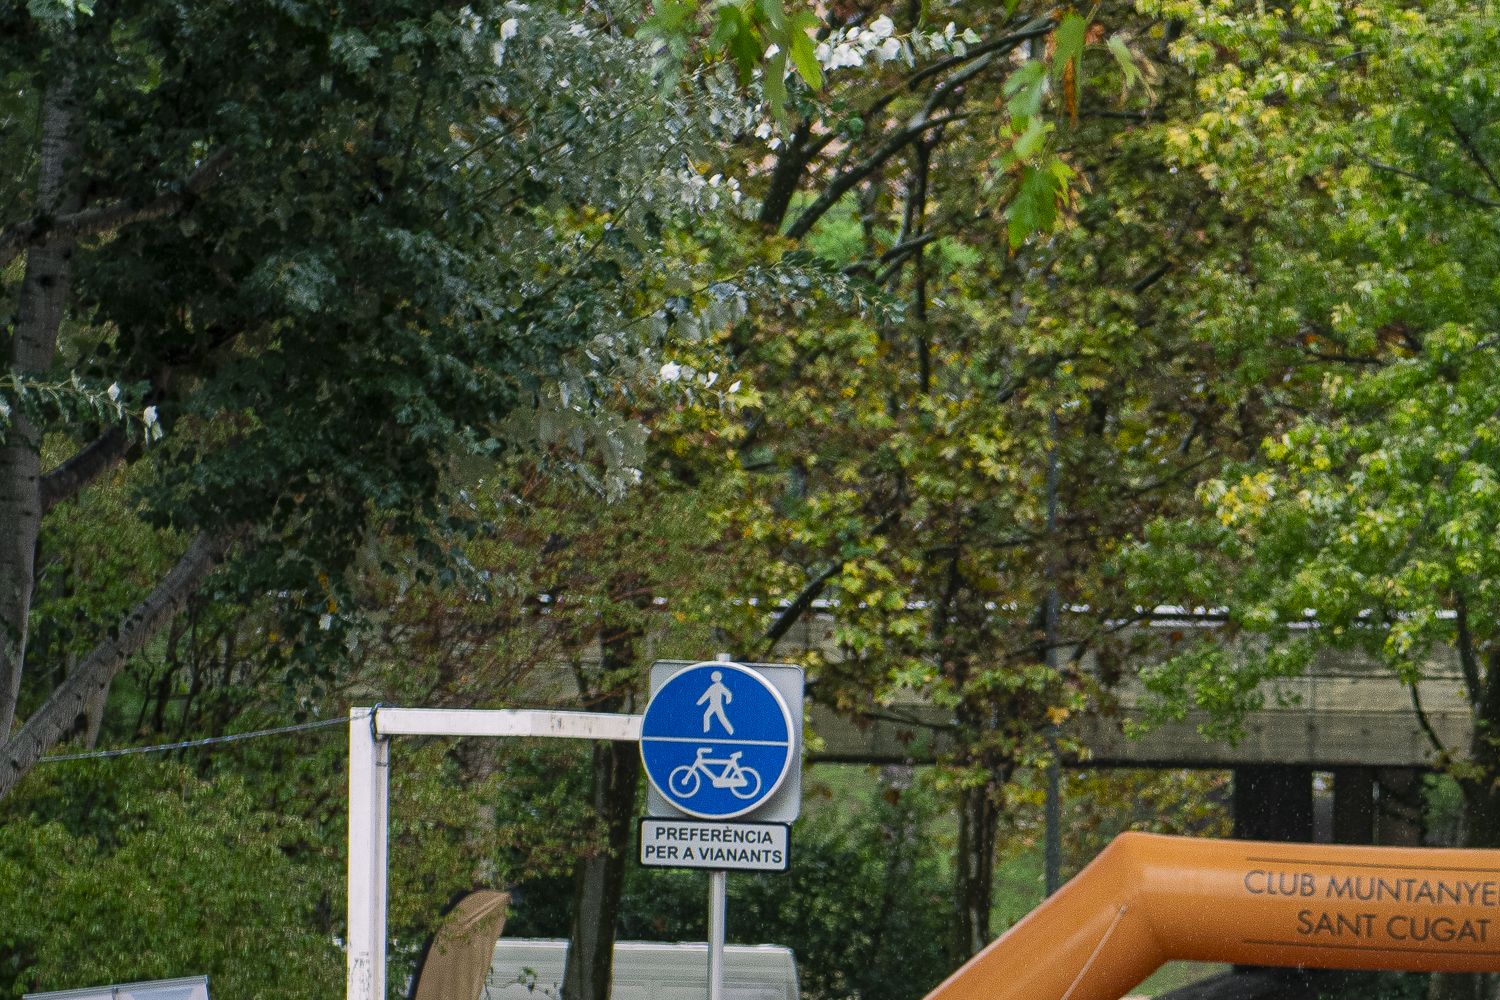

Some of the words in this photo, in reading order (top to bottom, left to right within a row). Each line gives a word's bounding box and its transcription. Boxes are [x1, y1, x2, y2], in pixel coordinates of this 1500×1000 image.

[655, 826, 773, 844] PREFERÈNCIA
[645, 845, 678, 859] PER
[682, 848, 694, 860] A
[699, 848, 782, 863] VIANANTS
[1244, 869, 1316, 899] CLUB
[1296, 909, 1377, 938] SANT
[1386, 915, 1492, 943] CUGAT
